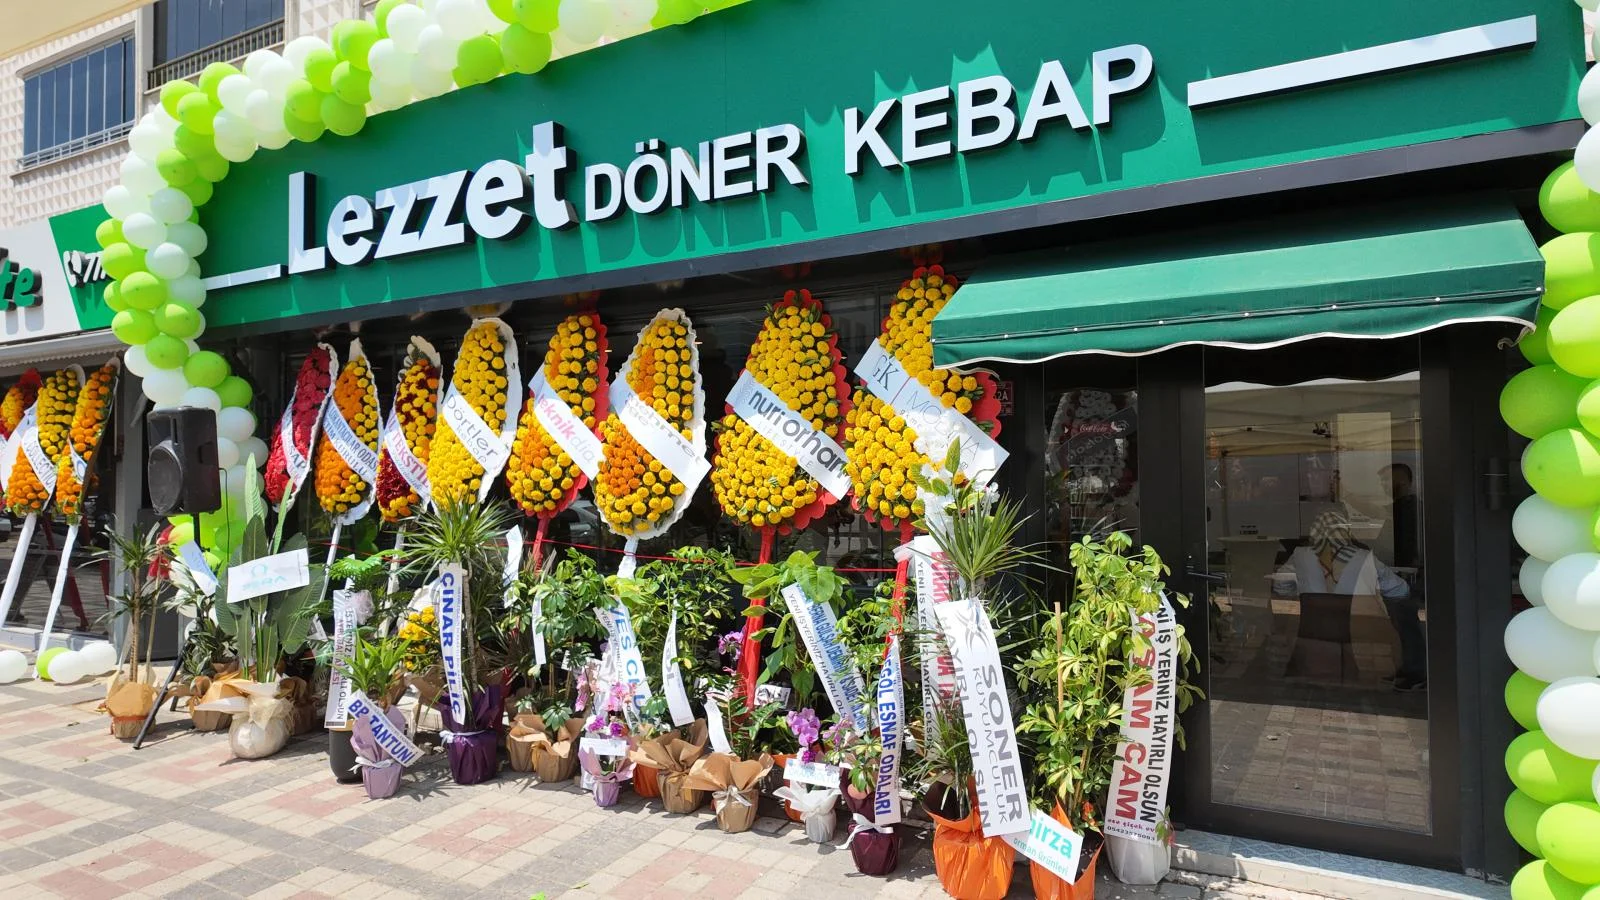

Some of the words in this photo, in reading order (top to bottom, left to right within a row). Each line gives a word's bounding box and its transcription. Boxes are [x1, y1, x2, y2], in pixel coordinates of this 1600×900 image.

[288, 120, 568, 274] Lezzet
[585, 123, 809, 222] DÖNER
[844, 43, 1154, 175] KEBAP
[440, 572, 455, 648] ÇINAR
[1155, 628, 1172, 645] İŞ
[348, 699, 369, 718] BP
[1153, 647, 1174, 711] YERİNİZ
[878, 701, 897, 750] ESNAF
[972, 667, 1008, 825] KUYUMCULUK
[982, 664, 1023, 823] SONER
[1149, 714, 1171, 771] HAYIRLI
[875, 754, 895, 816] ODALARI
[1114, 742, 1148, 821] CAM
[1140, 773, 1162, 824] OLSUN
